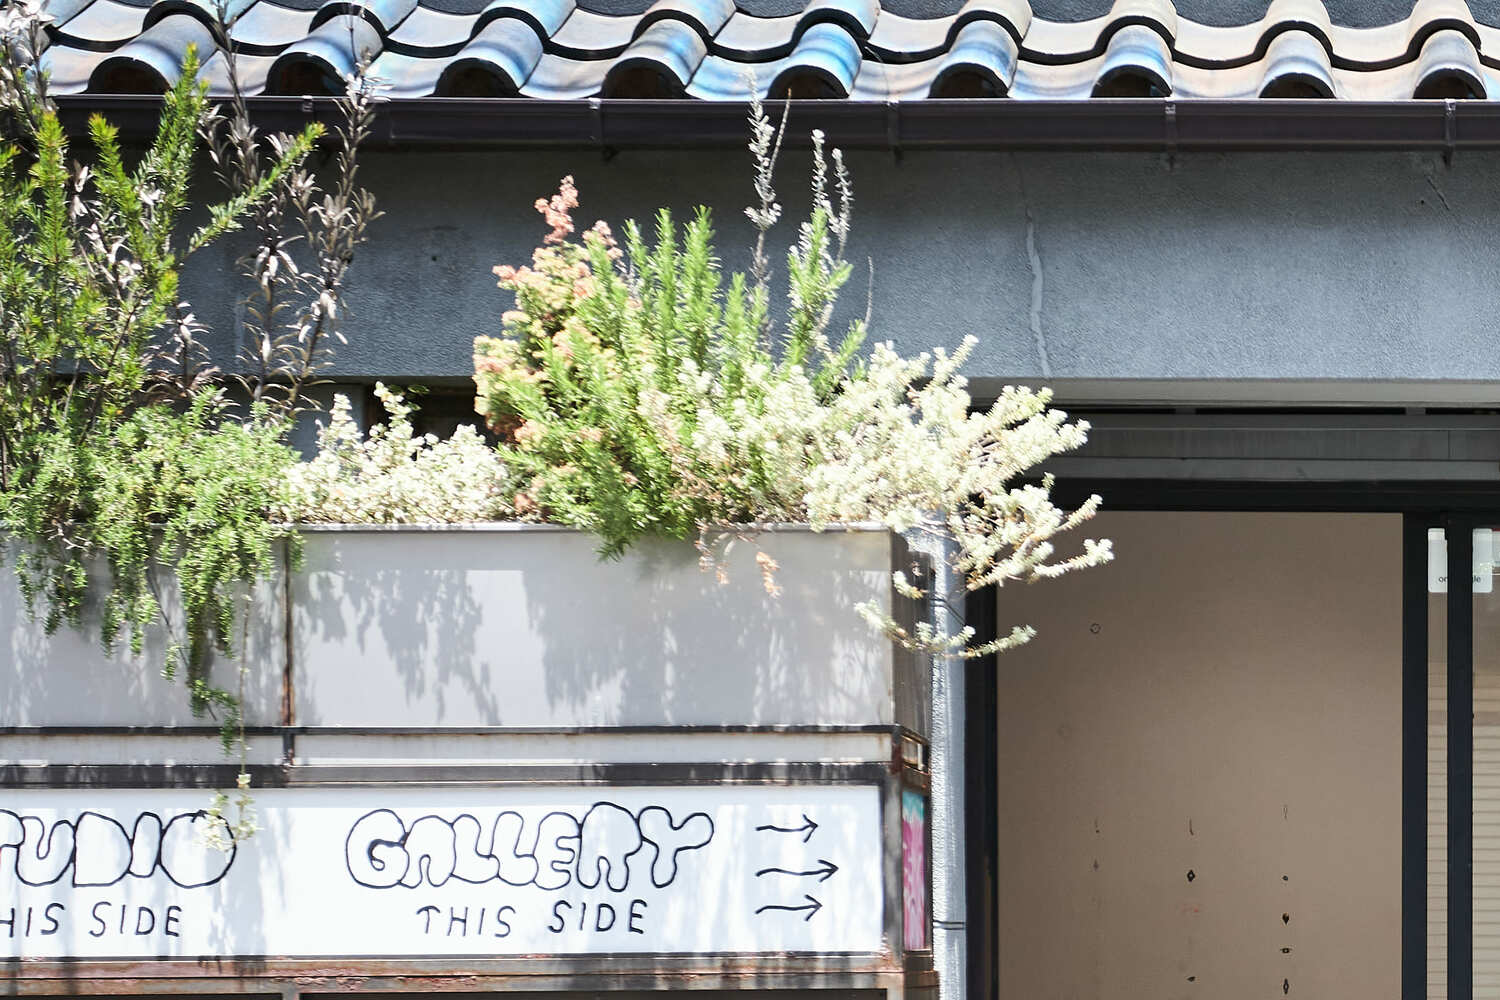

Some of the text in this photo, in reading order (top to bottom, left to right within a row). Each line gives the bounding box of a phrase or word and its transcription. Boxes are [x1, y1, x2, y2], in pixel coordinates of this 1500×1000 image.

[345, 801, 714, 892] GALLERY
[89, 901, 182, 937] SIDE
[416, 900, 647, 937] THIS SIDE
